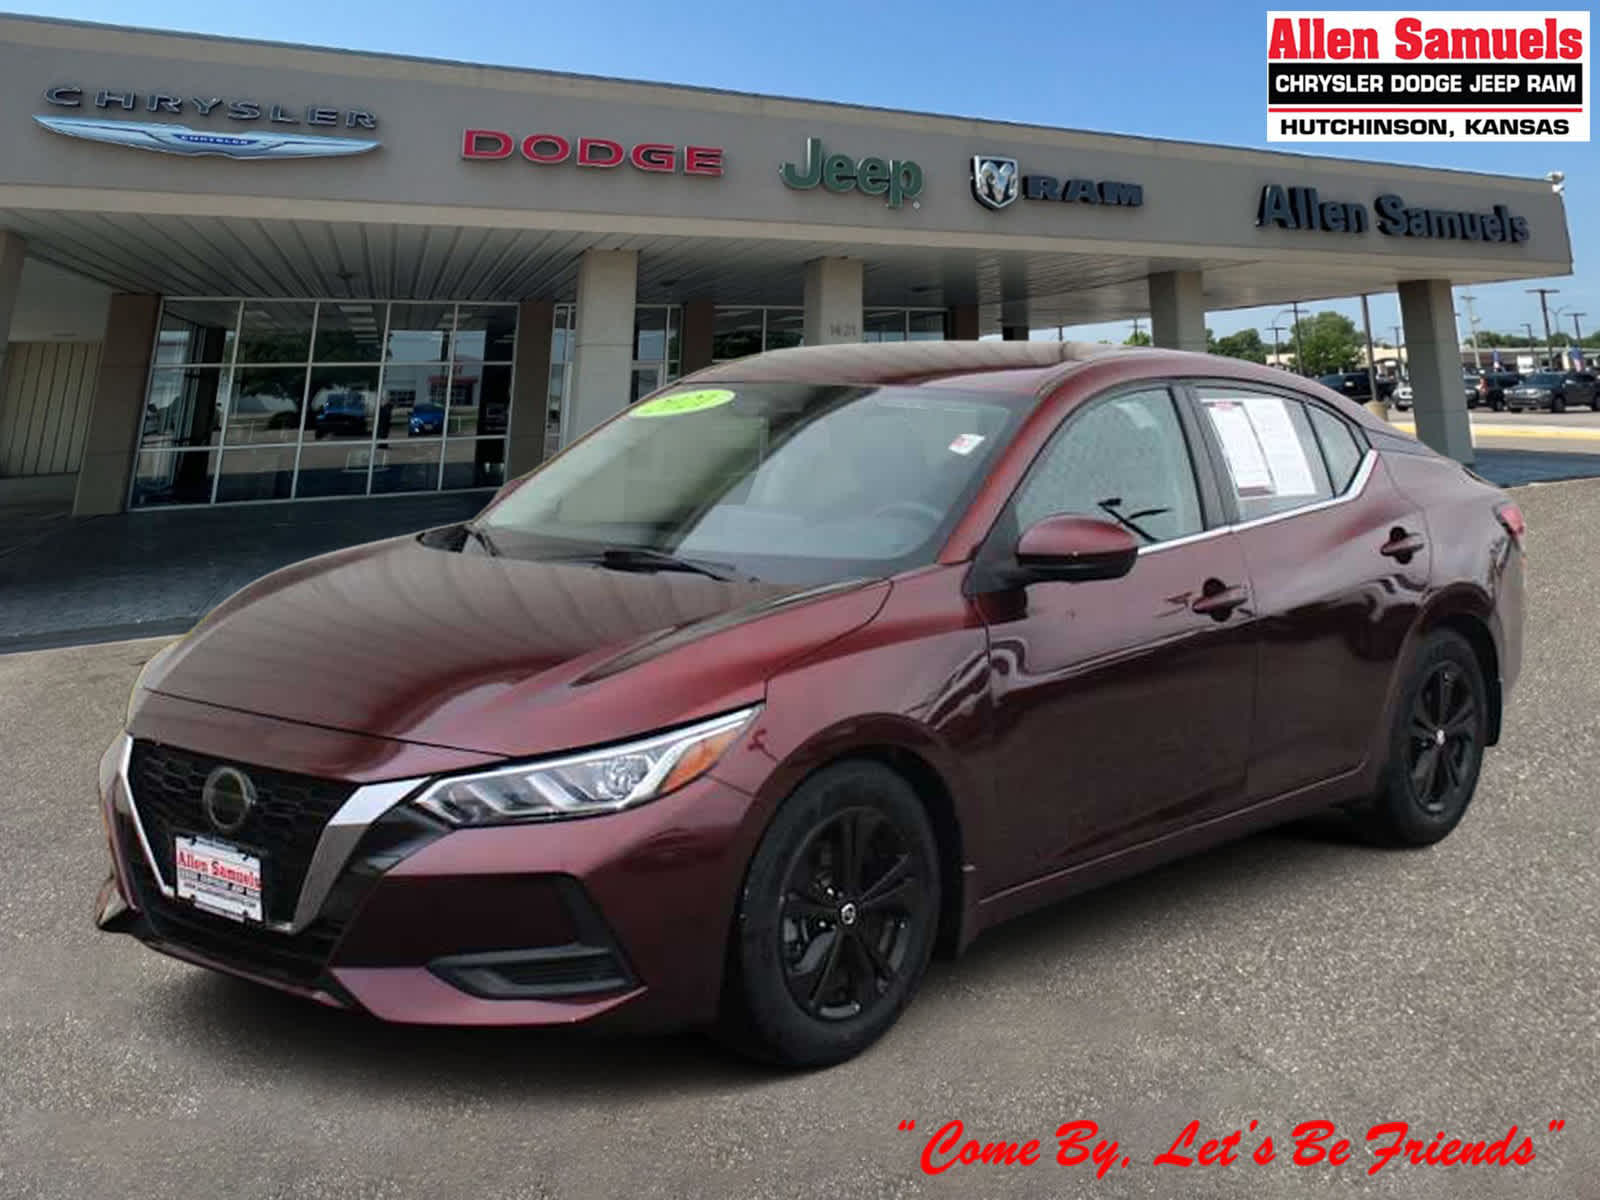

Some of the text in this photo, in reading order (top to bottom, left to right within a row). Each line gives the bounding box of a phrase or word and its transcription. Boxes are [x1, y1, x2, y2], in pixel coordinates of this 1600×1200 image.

[43, 86, 378, 129] CHRYSLER
[462, 128, 725, 176] DODGE
[779, 136, 924, 209] Jeep
[1023, 175, 1144, 207] RAM
[1255, 184, 1530, 243] Allen Samuels
